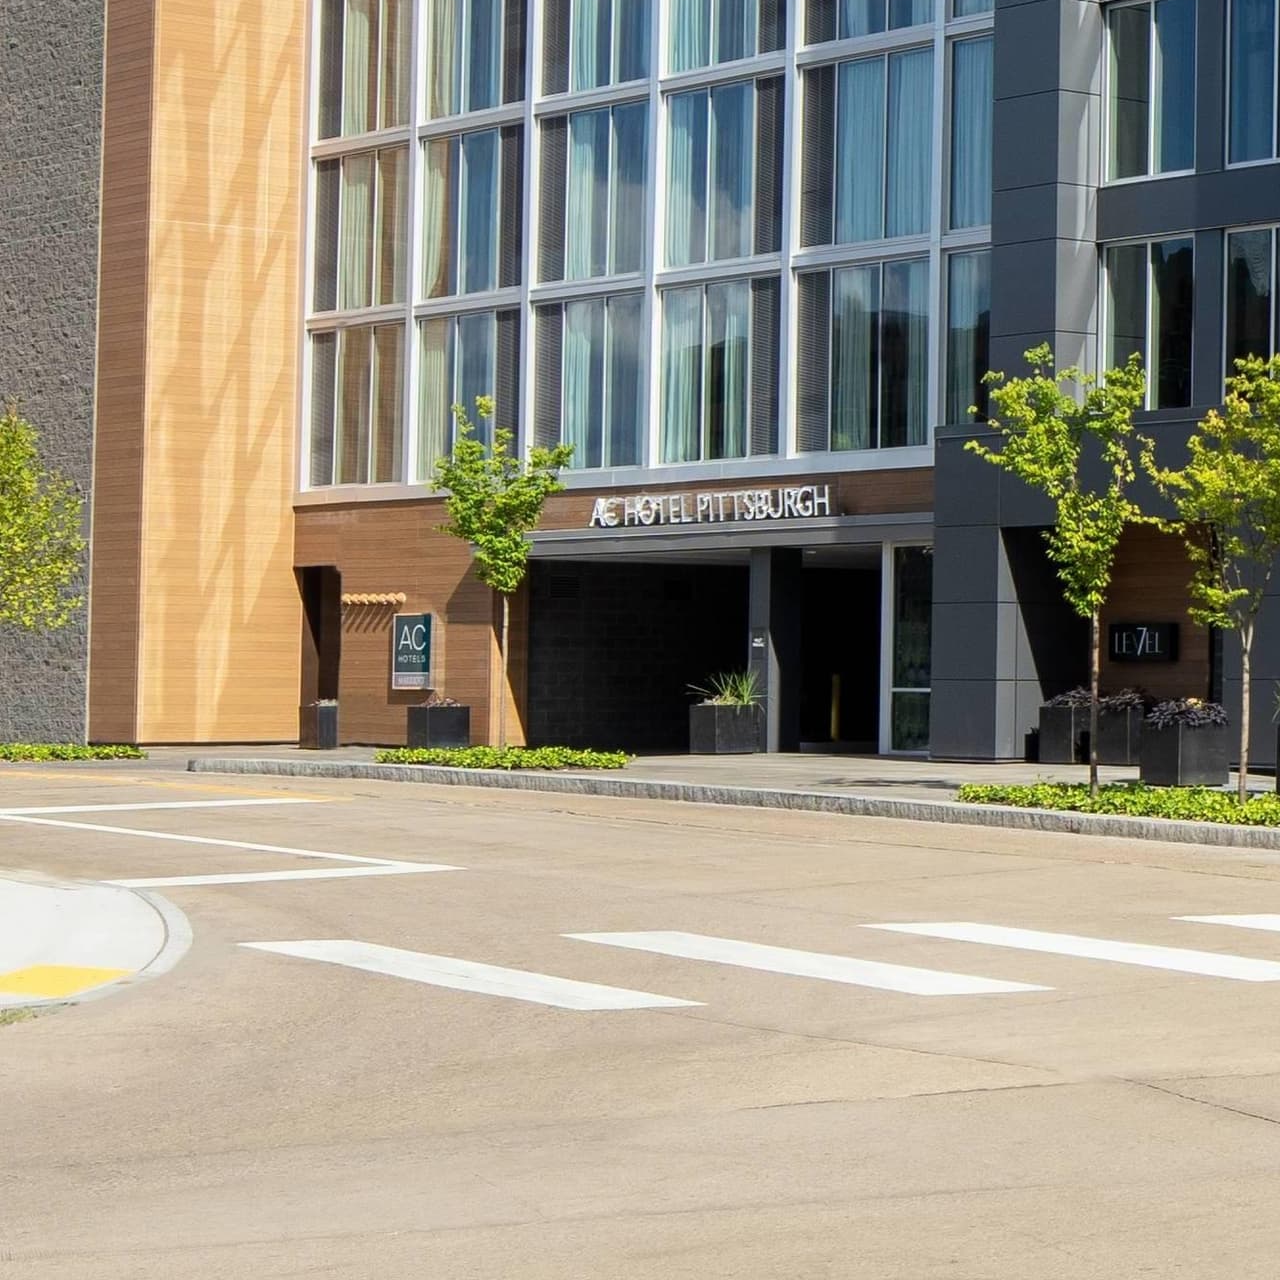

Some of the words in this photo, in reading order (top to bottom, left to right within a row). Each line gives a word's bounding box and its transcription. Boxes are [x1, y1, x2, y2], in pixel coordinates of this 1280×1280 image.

[589, 497, 621, 528] AC
[624, 493, 694, 526] HOTEL
[697, 484, 831, 522] PITTSBURGH
[398, 624, 427, 650] AC
[398, 654, 426, 663] HOTELS
